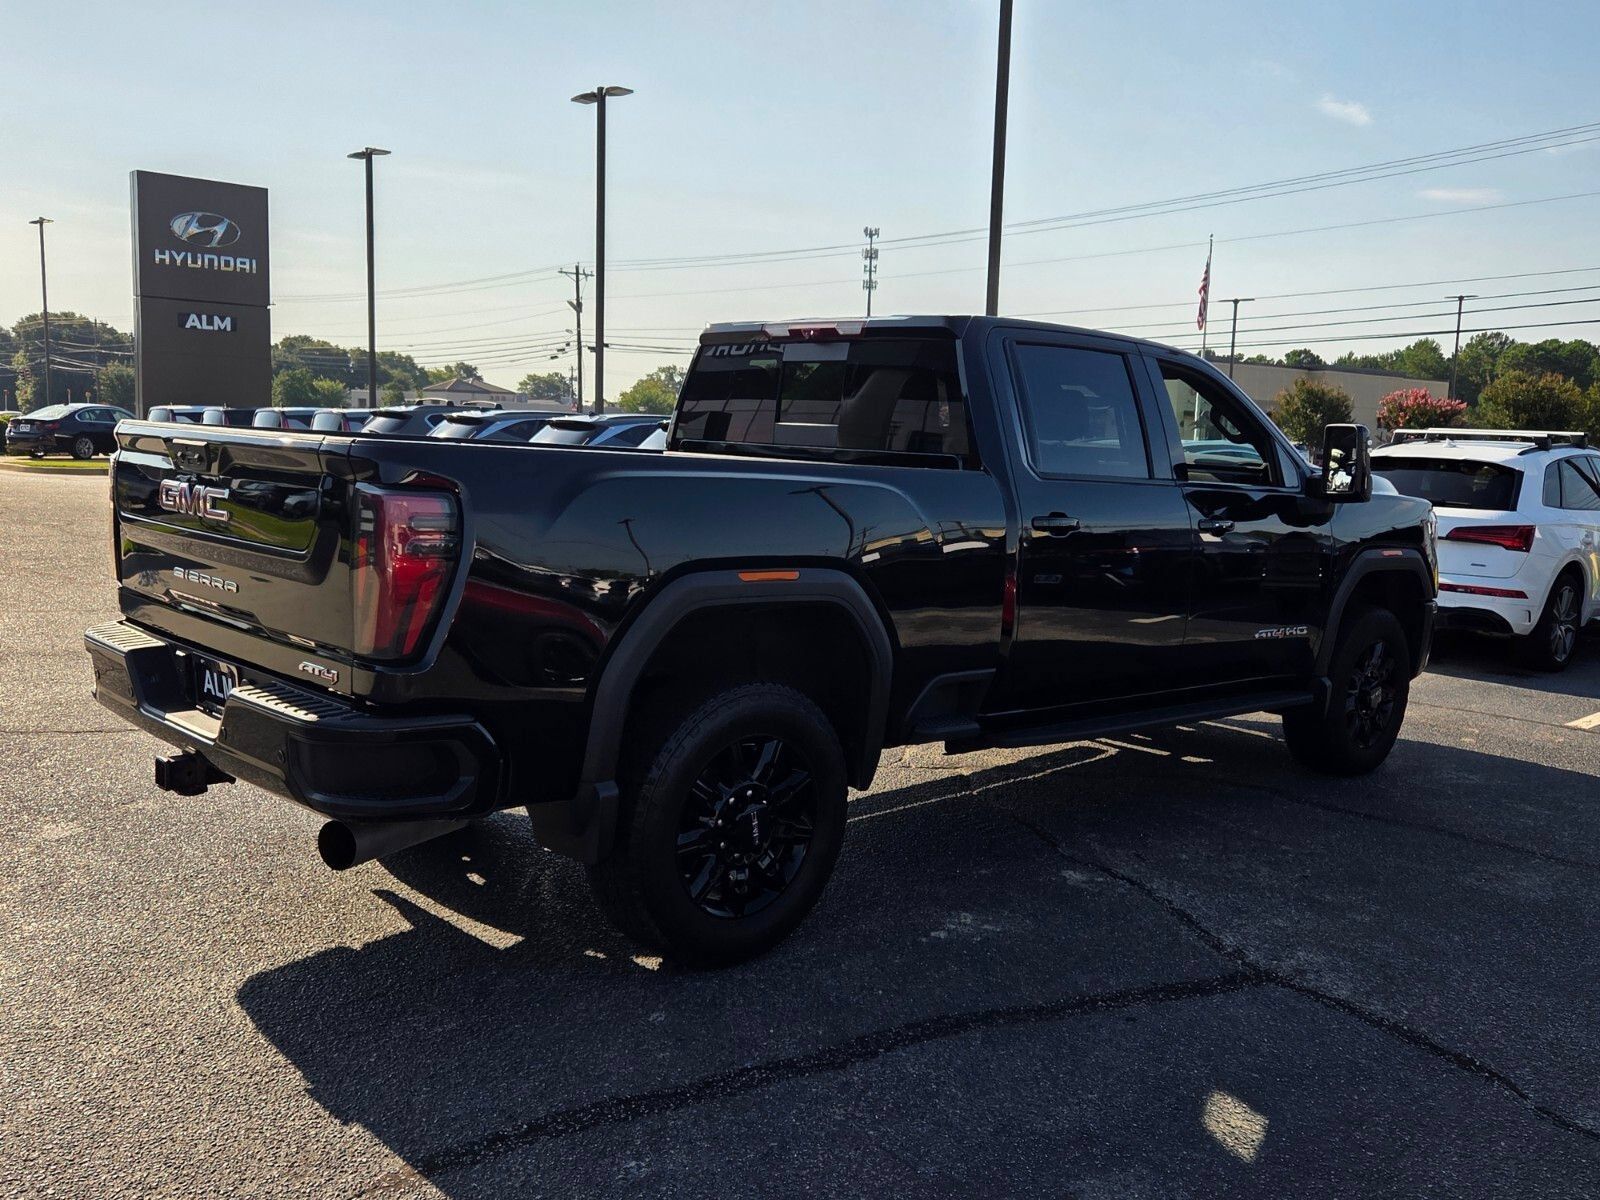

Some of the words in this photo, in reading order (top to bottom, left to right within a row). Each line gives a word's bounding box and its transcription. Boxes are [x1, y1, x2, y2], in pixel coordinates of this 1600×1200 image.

[154, 248, 257, 274] HYUNDAI
[185, 313, 232, 332] ALM
[159, 479, 230, 521] GMC
[173, 566, 239, 593] SIERRA
[298, 661, 338, 685] AT4
